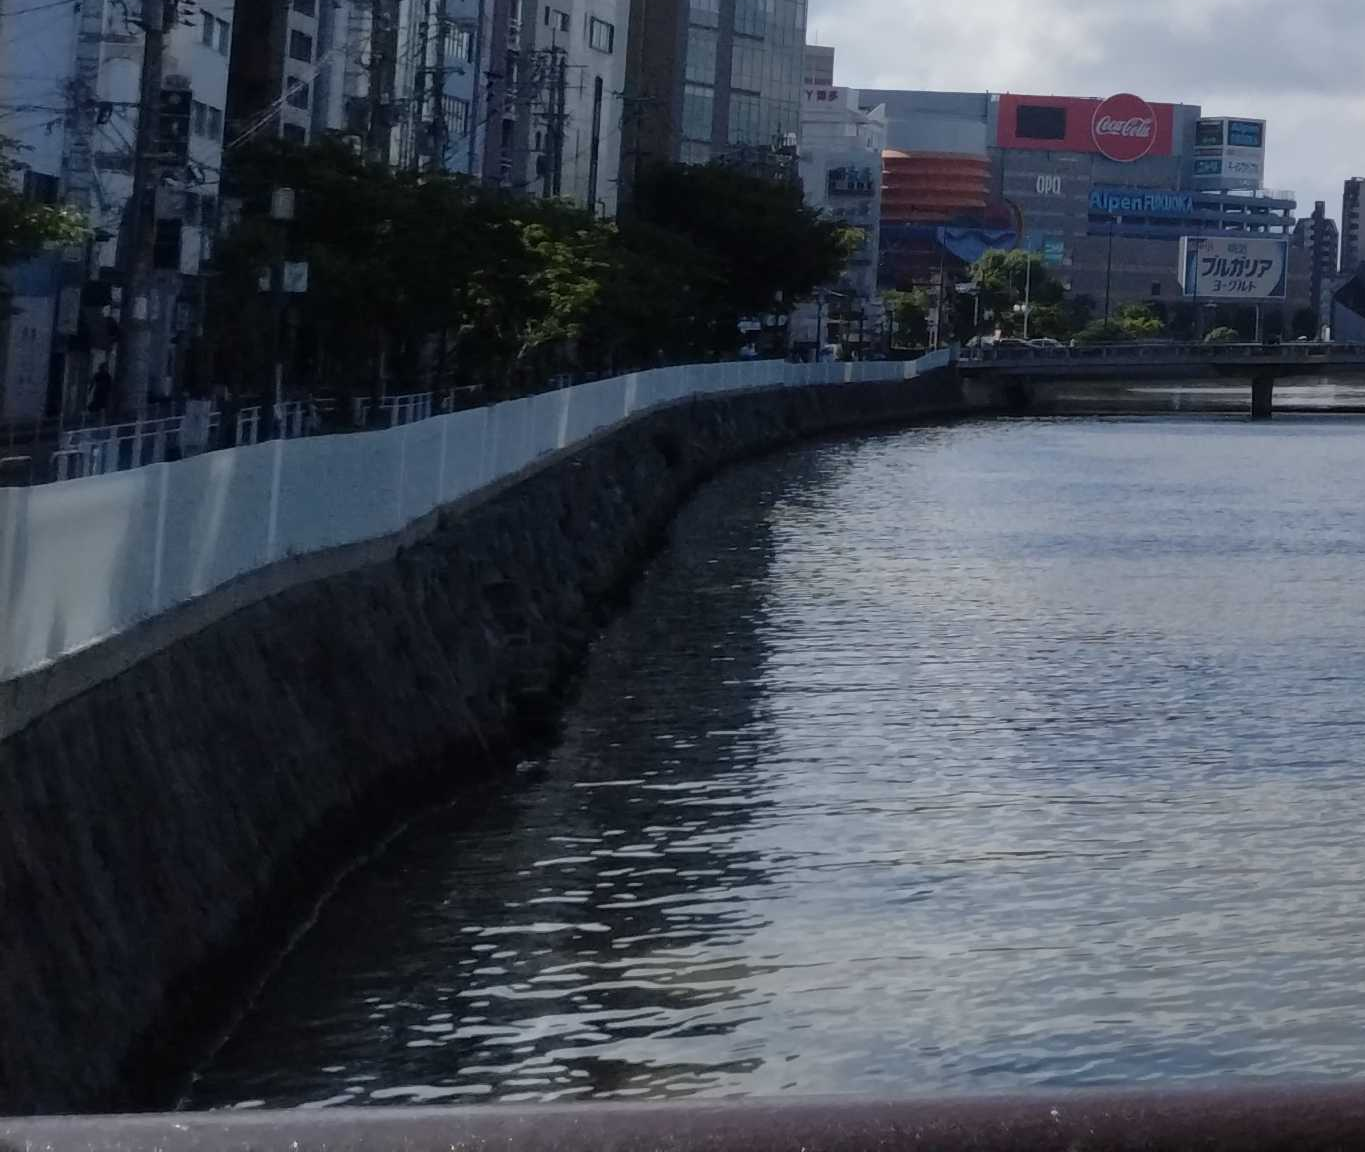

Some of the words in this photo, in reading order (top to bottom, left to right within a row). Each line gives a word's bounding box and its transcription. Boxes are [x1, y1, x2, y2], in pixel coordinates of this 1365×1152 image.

[1201, 255, 1273, 278] ブルガリア
